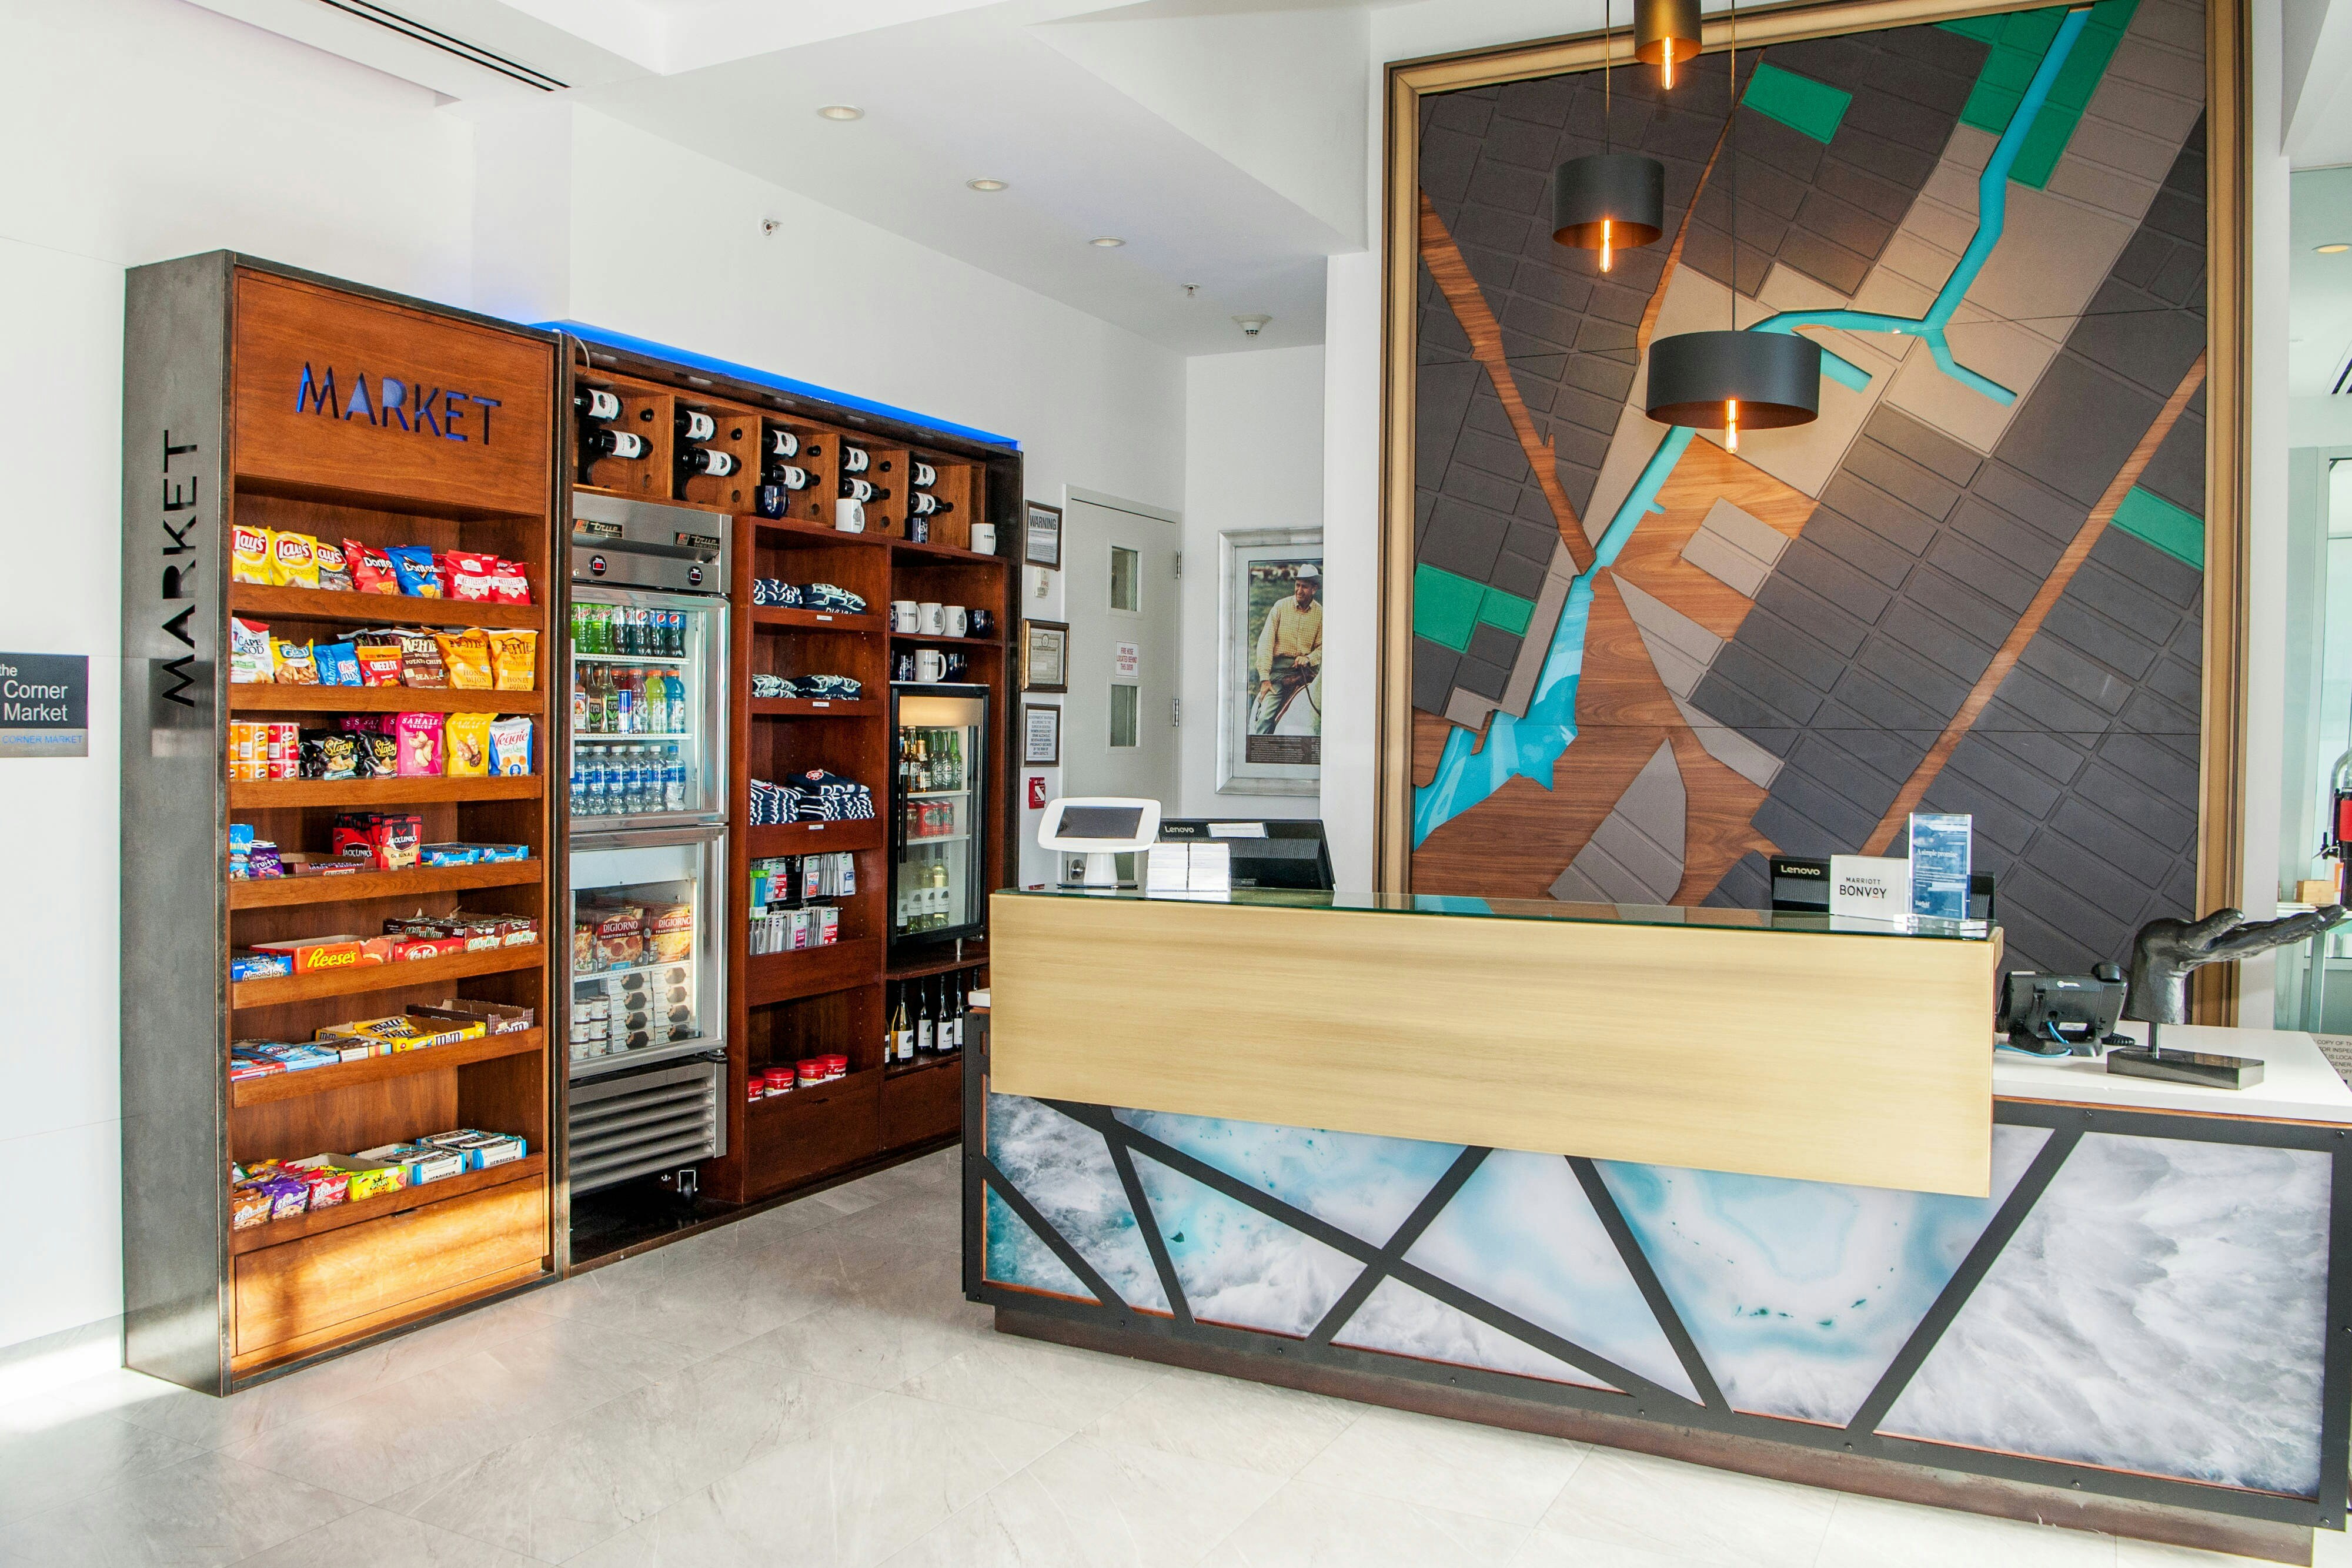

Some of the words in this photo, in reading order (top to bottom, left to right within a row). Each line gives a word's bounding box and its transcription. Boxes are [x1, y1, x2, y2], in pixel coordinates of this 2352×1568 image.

[296, 361, 502, 446] MARKET
[1030, 515, 1057, 530] WARNING
[235, 531, 265, 553] Lay's
[279, 541, 310, 559] Lay's
[318, 548, 342, 564] ay's
[162, 430, 198, 707] MARKET
[363, 557, 395, 569] Dorito
[403, 562, 436, 573] Doritos
[238, 636, 263, 646] CAPE
[242, 646, 265, 655] COD
[339, 661, 356, 673] Chex
[4, 680, 69, 699] Corner
[4, 703, 68, 721] Market
[2, 735, 42, 744] CORNER
[45, 735, 83, 744] MARKET
[493, 729, 528, 748] Veggie
[374, 740, 397, 757] Stacy
[1164, 825, 1195, 834] Lenovo
[1780, 865, 1820, 875] Lenovo
[1846, 877, 1881, 885] MARRIOTT
[1839, 885, 1887, 898] BONVOY
[603, 921, 638, 933] DIGIORNO
[658, 917, 691, 928] DIGIORNO
[469, 938, 487, 951] Milky
[506, 934, 523, 945] Milky
[307, 947, 356, 968] Reese's
[242, 970, 272, 981] Almond
